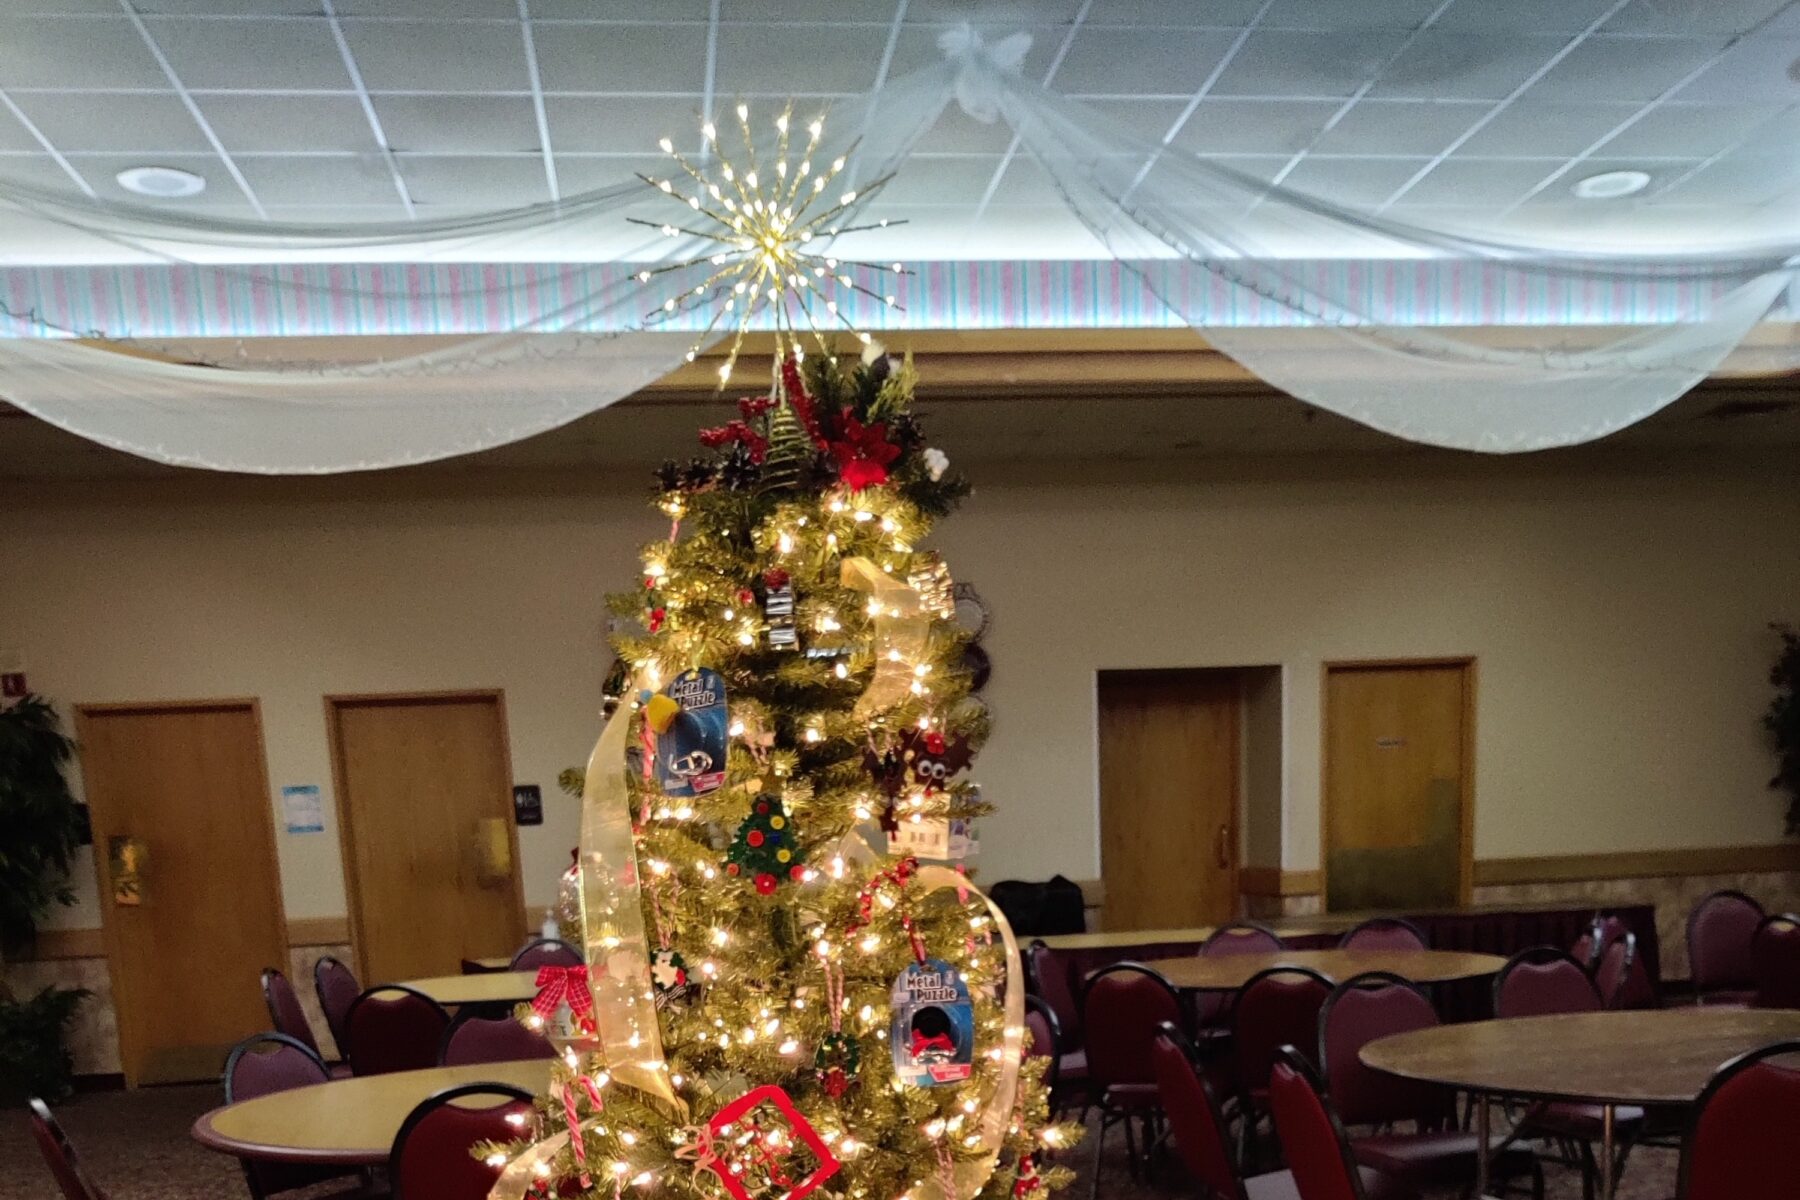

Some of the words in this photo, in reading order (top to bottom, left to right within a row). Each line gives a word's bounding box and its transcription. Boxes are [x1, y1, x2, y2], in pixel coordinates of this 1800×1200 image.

[672, 679, 704, 698] Metal
[678, 690, 716, 711] Puzzle
[906, 972, 941, 990] Metal
[916, 987, 957, 1004] Puzzle
